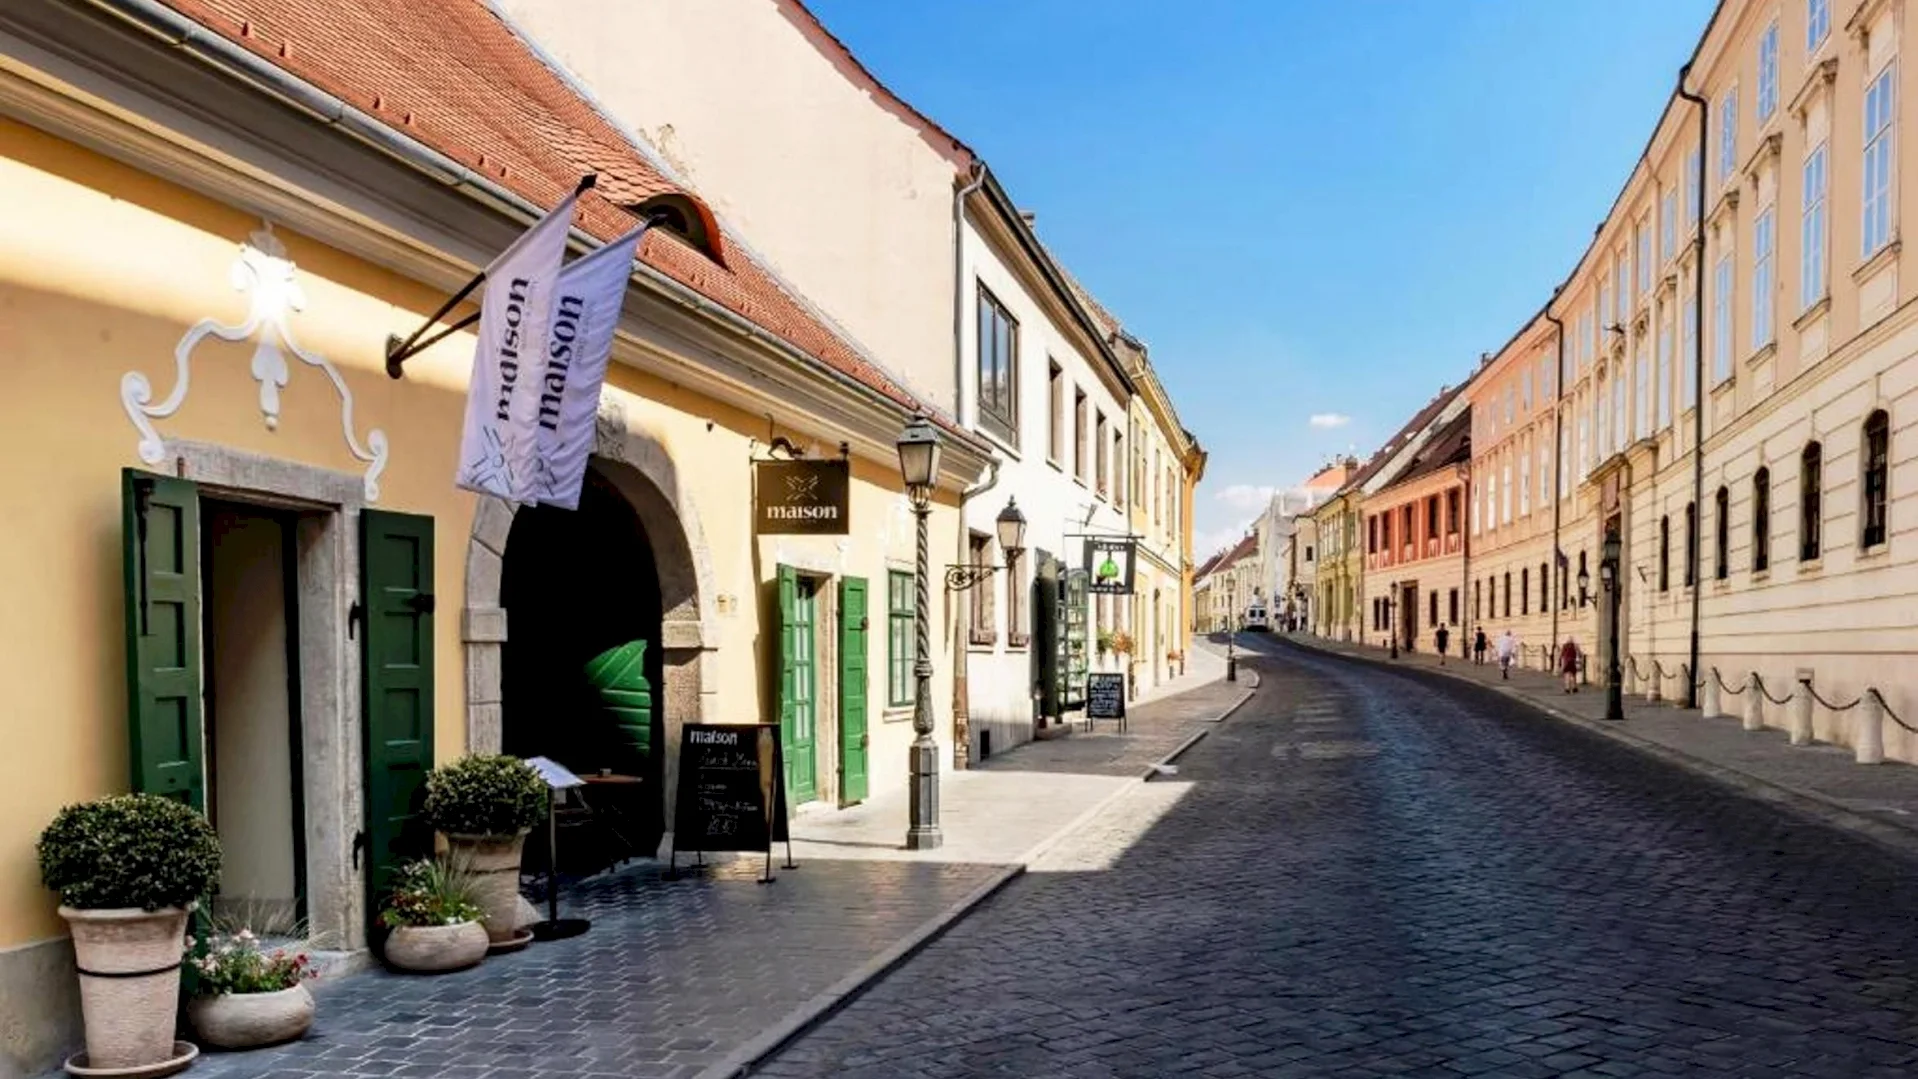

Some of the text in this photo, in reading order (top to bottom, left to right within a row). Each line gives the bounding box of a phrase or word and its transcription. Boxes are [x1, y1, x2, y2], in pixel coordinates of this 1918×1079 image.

[496, 277, 530, 422] maison
[538, 295, 584, 431] maison
[767, 506, 838, 519] maison
[690, 729, 738, 746] maison
